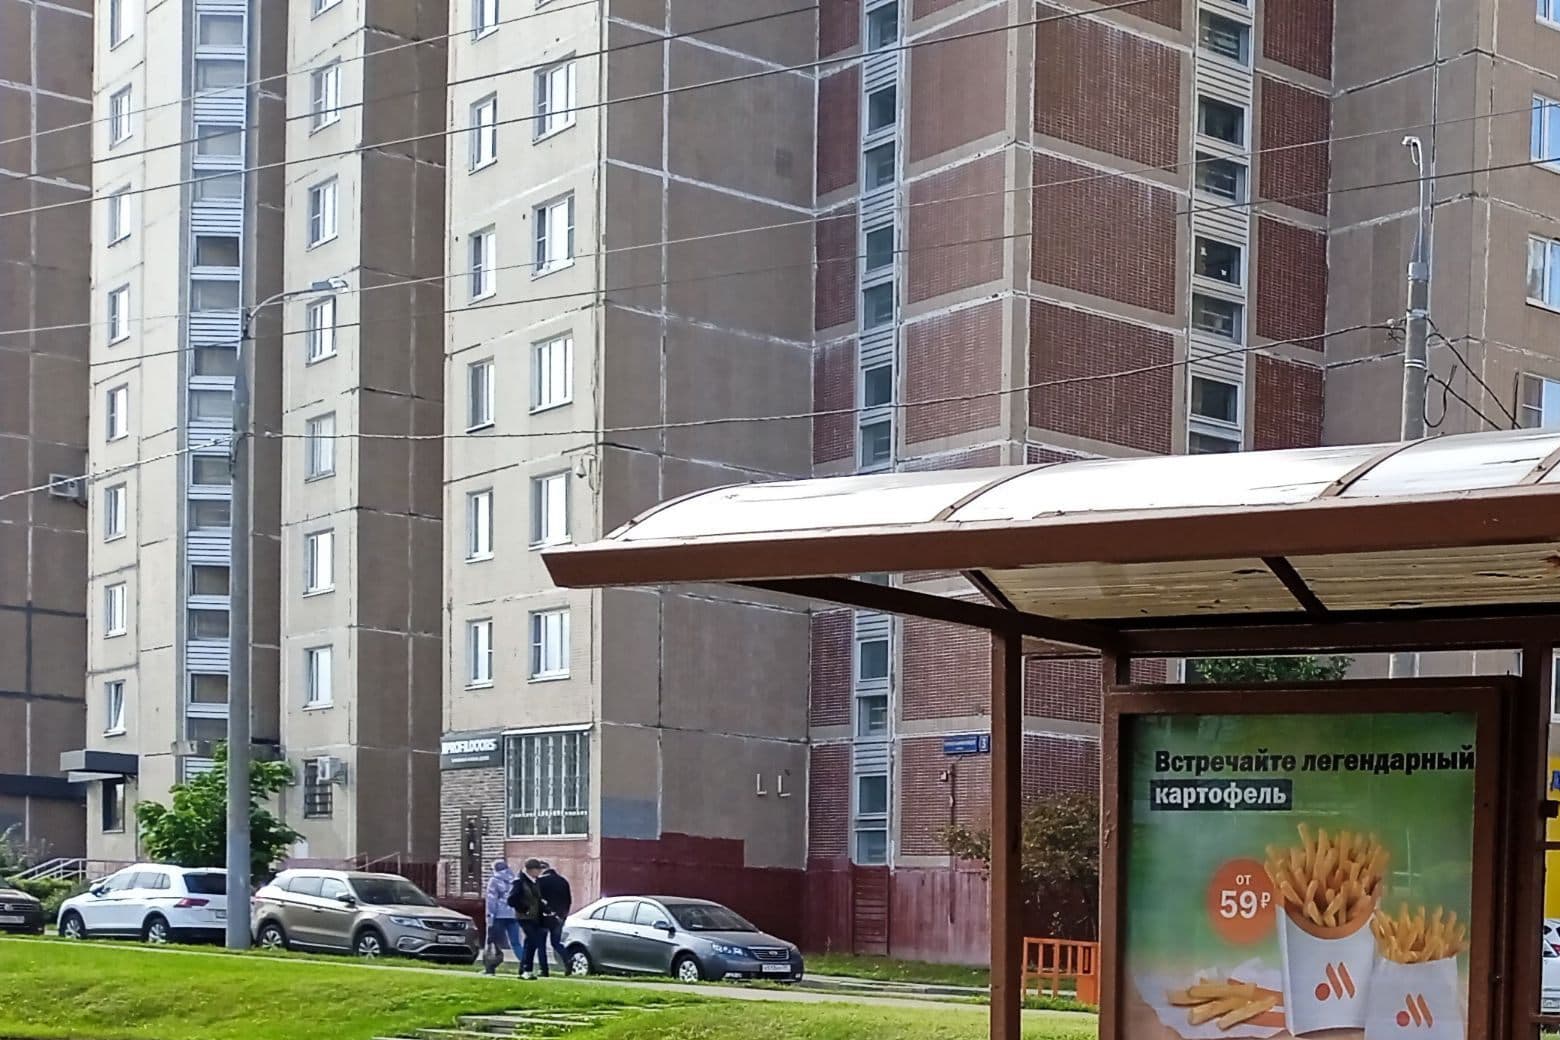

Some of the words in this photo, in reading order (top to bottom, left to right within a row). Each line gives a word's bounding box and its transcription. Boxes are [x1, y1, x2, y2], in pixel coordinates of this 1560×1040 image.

[1155, 748, 1297, 776] Встречайте
[1301, 744, 1475, 775] легендарный
[1155, 781, 1288, 809] картофель
